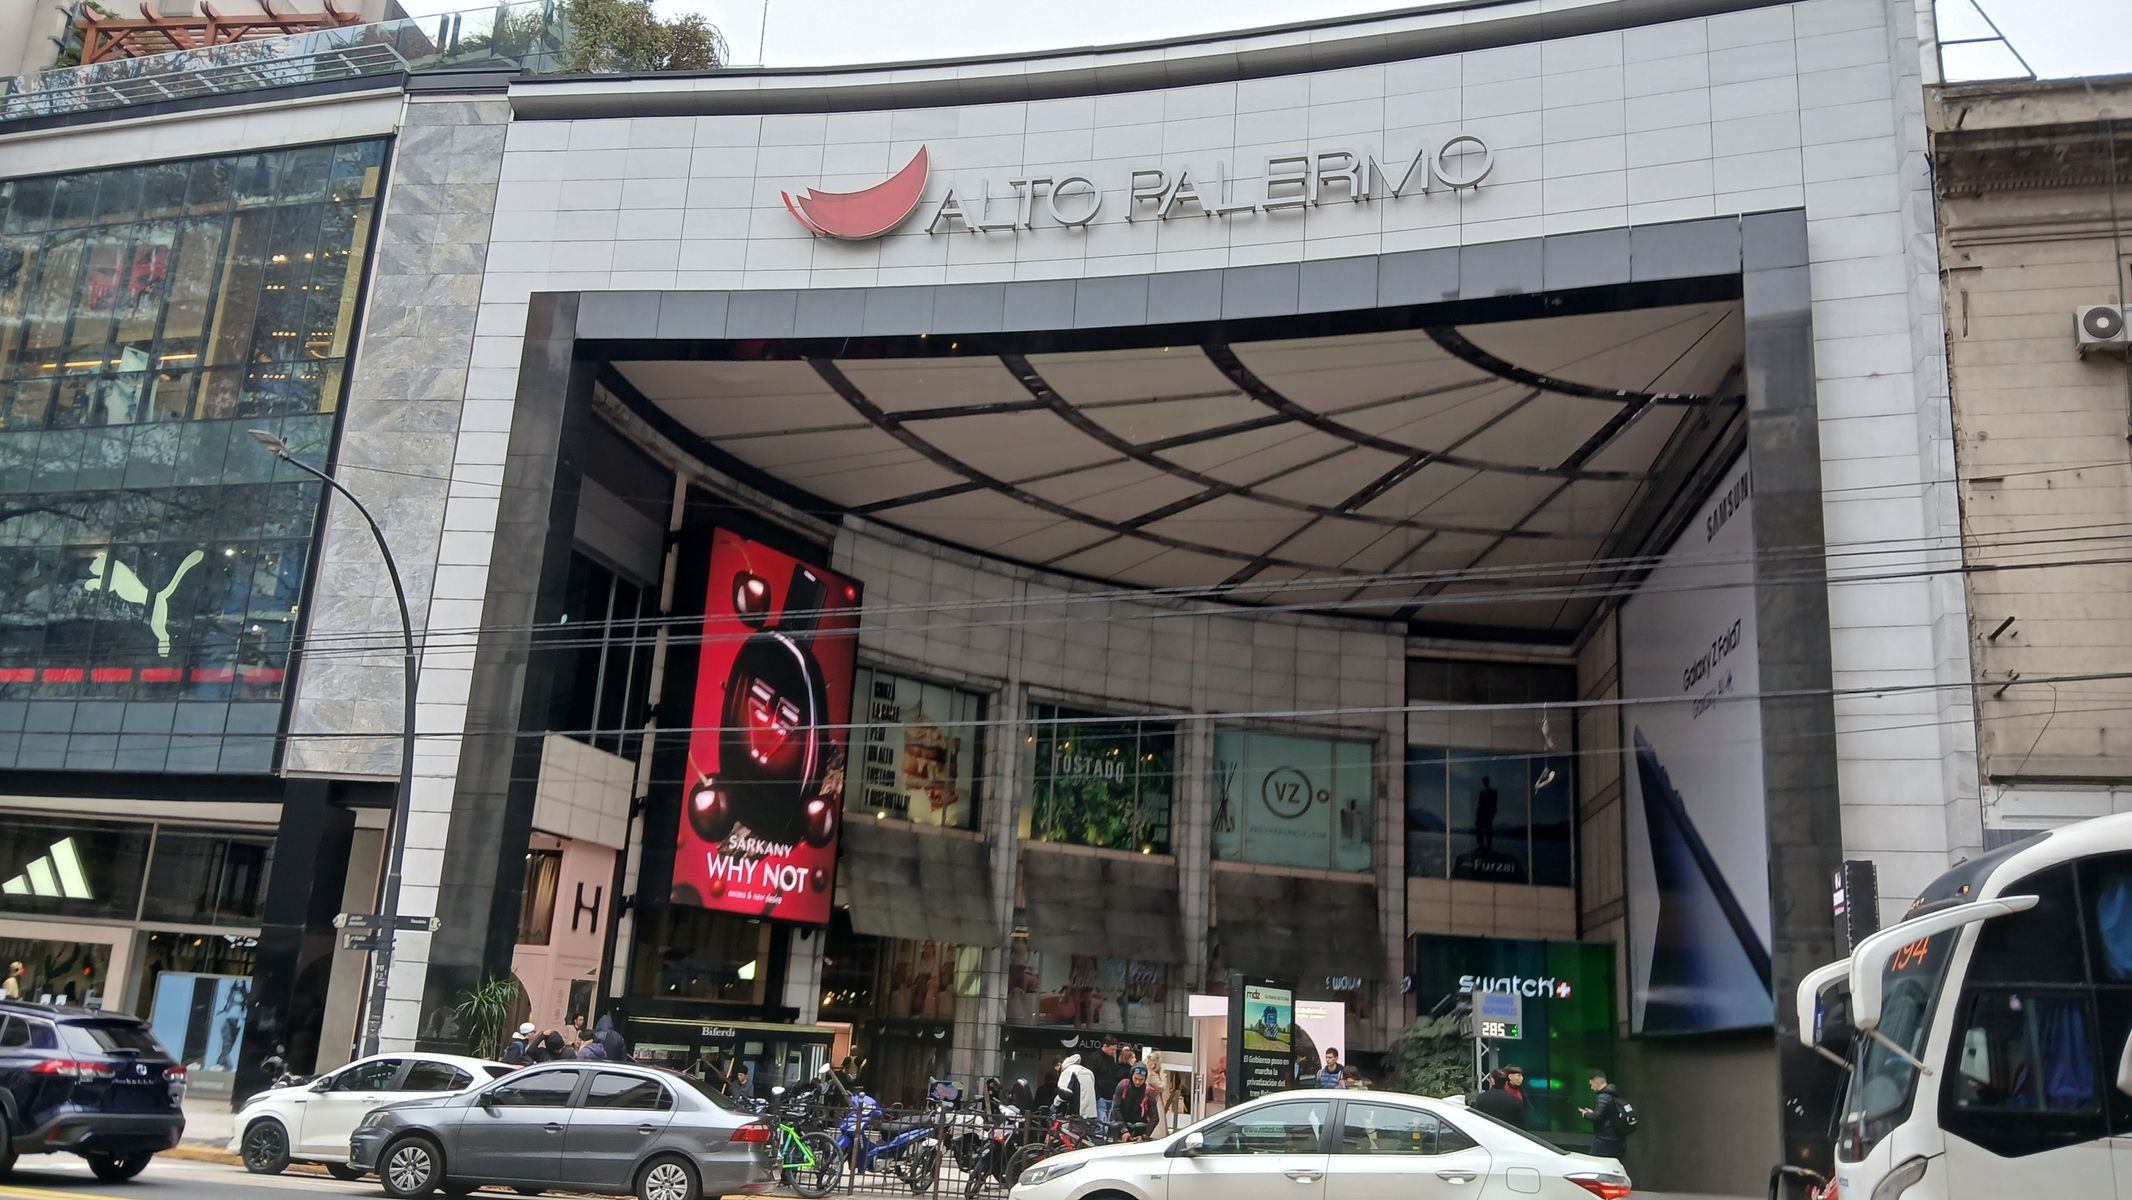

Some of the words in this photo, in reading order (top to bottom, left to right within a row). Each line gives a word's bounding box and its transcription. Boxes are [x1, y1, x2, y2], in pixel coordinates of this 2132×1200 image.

[925, 176, 1101, 233] ALTO
[1129, 136, 1494, 221] PALERMO
[1707, 471, 1754, 543] SAMSUN
[1683, 652, 1711, 692] Galaxy
[1054, 752, 1125, 784] TOSTADO
[1275, 781, 1301, 804] VZ
[729, 834, 793, 859] SARKANY
[707, 852, 759, 885] WHY
[762, 862, 809, 893] NOT
[1247, 989, 1261, 1000] mdz
[1459, 975, 1556, 999] swatch
[701, 1026, 736, 1037] Biferdi
[1482, 1022, 1505, 1036] 285
[1079, 1039, 1101, 1049] ALTO
[1249, 1055, 1271, 1064] Gobierno
[1254, 1067, 1273, 1075] marcha
[1278, 1079, 1286, 1087] del
